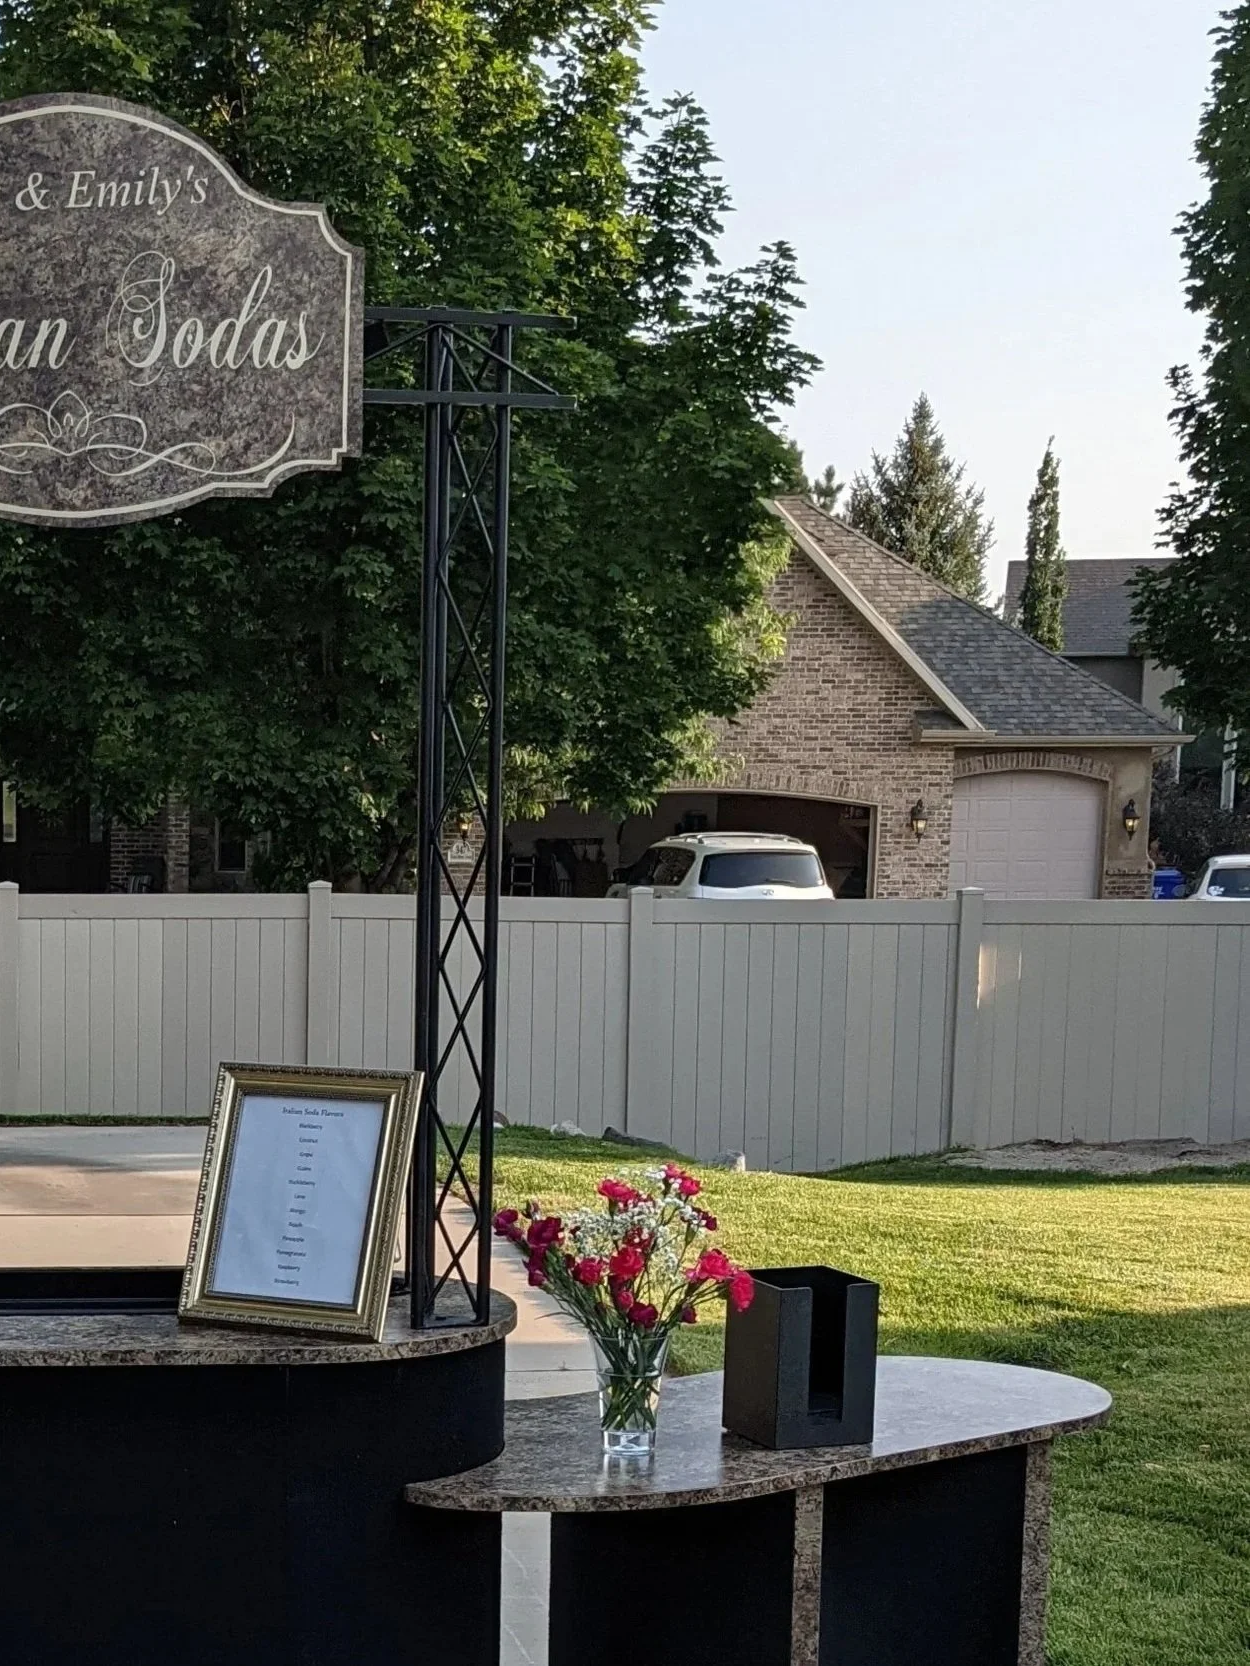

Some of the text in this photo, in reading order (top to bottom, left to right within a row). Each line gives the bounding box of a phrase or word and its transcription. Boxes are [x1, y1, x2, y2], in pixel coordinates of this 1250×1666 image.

[15, 172, 51, 211] &
[65, 165, 209, 215] Emily's
[106, 250, 325, 386] Sodas
